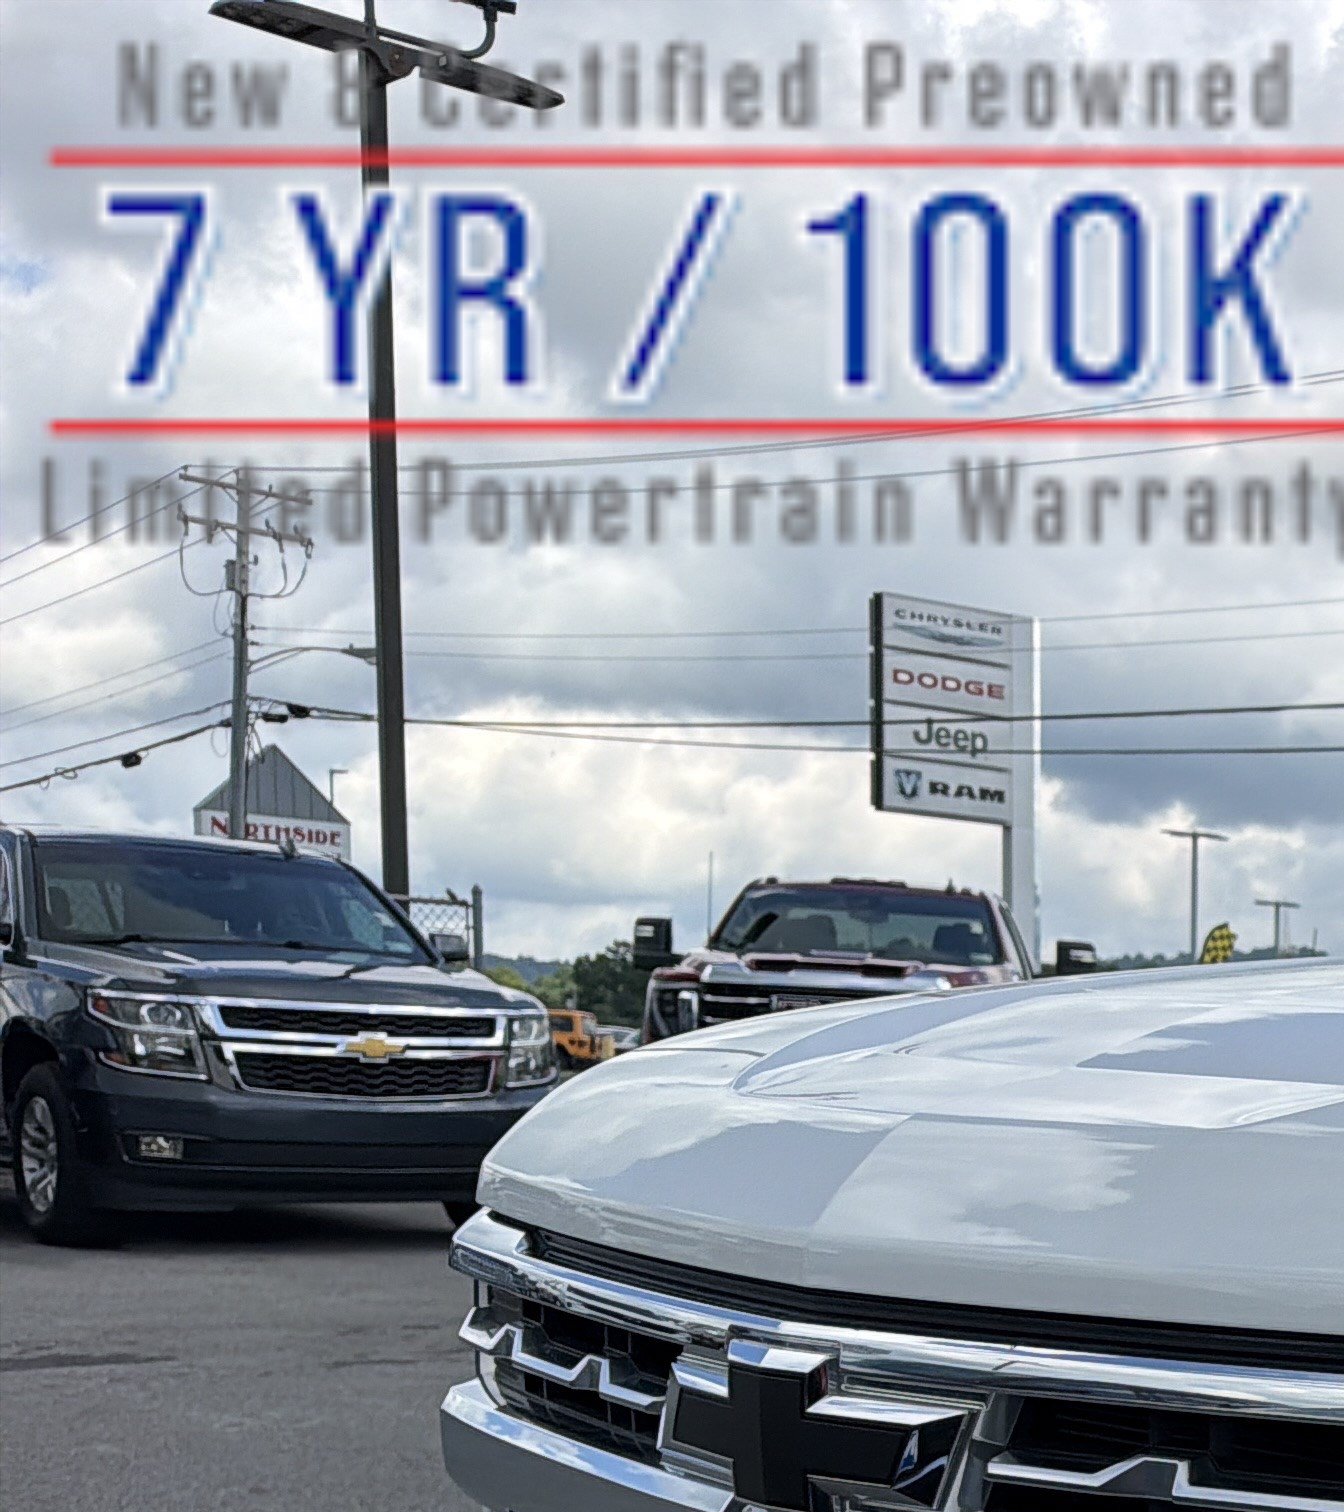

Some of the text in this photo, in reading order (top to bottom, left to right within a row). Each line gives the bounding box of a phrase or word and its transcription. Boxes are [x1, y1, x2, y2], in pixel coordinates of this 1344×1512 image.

[894, 608, 1003, 635] CHRYSLER
[892, 668, 1006, 700] DODGE
[912, 718, 989, 757] Jeep
[928, 781, 1006, 804] RAM
[210, 815, 341, 847] NRTHSIDE
